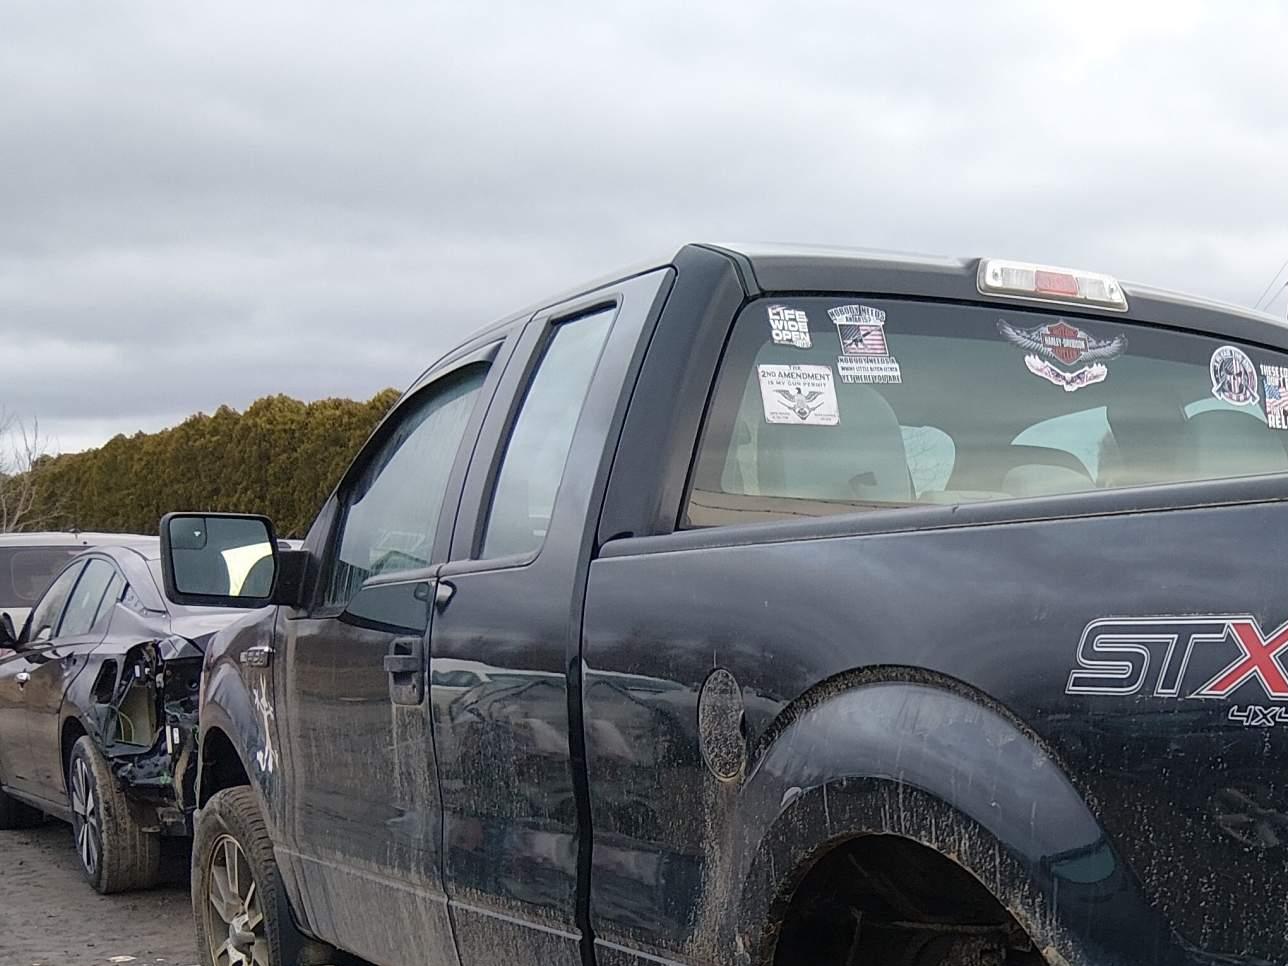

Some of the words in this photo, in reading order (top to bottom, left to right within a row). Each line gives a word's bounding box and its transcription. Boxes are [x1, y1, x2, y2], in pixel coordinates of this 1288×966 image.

[768, 306, 808, 321] LIFE
[769, 320, 809, 332] WIDE
[772, 330, 811, 342] OPEN
[778, 371, 831, 380] AMENDMENT
[1260, 364, 1280, 377] THESE
